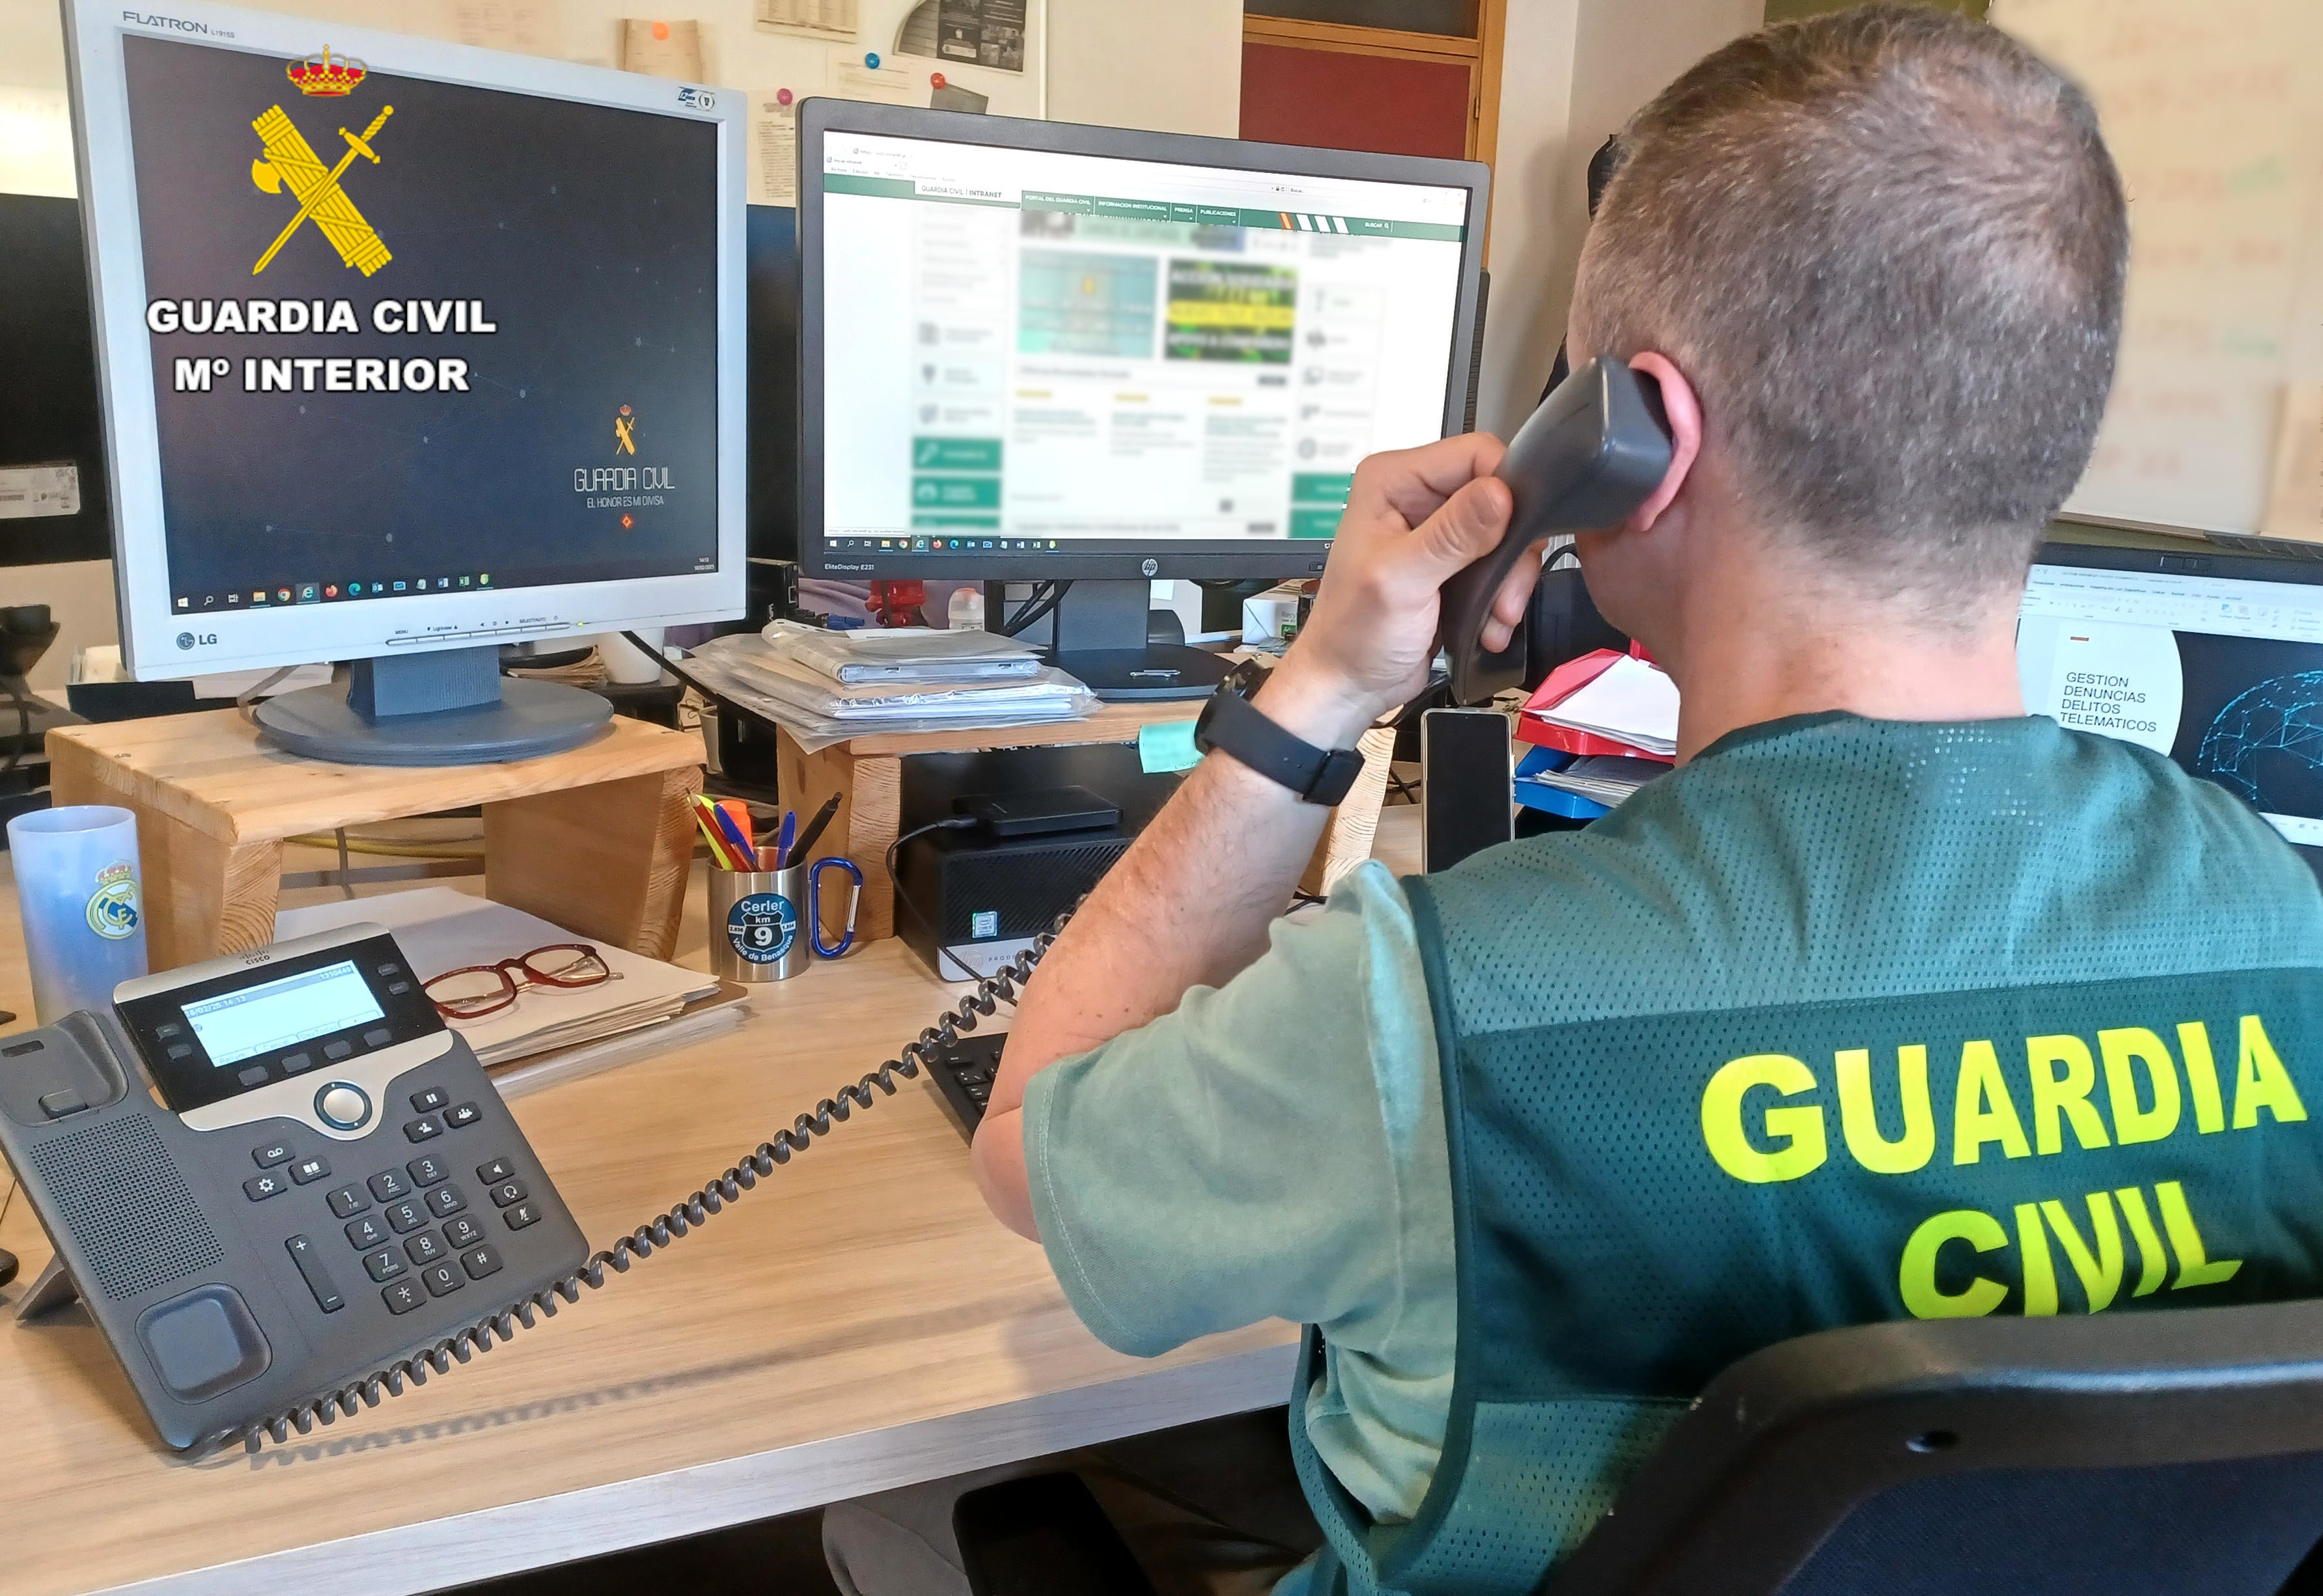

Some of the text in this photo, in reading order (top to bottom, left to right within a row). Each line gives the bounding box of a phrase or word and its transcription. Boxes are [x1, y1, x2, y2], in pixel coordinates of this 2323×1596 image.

[122, 10, 208, 34] FLATRON
[921, 186, 948, 194] GUARDIA
[969, 189, 1002, 199] INTRANET
[1132, 204, 1167, 212] INSTITUCIONAL
[1200, 208, 1236, 217] PUBLICACIONES
[574, 466, 675, 492] GUARDIA CIVIL
[587, 495, 664, 508] EL HONOR ES MI DIVISA
[824, 563, 859, 571] EliteDisplay
[1143, 559, 1157, 576] hp
[199, 633, 217, 645] LG
[2066, 672, 2129, 688] GESTION
[2063, 685, 2147, 704] DENUNCIAS
[2061, 698, 2121, 714] DELITOS
[2060, 711, 2157, 732] TELEMATICOS
[740, 900, 785, 913] Cerler
[755, 916, 771, 924] km
[754, 926, 773, 946] 9
[733, 935, 794, 961] Valle de Benasque
[1701, 1014, 2308, 1184] GUARDIA
[422, 1160, 434, 1172] 3
[383, 1175, 396, 1189] 2
[342, 1191, 353, 1202] 1
[440, 1190, 452, 1204] 6
[400, 1205, 413, 1218] 5
[363, 1221, 374, 1233] 4
[458, 1220, 469, 1234] 9
[460, 1229, 478, 1241] WXYZ
[419, 1237, 431, 1250] 8
[1899, 1181, 2244, 1319] CIVIL
[424, 1247, 436, 1256] TUV
[379, 1254, 389, 1267] 7
[438, 1269, 450, 1282] 0
